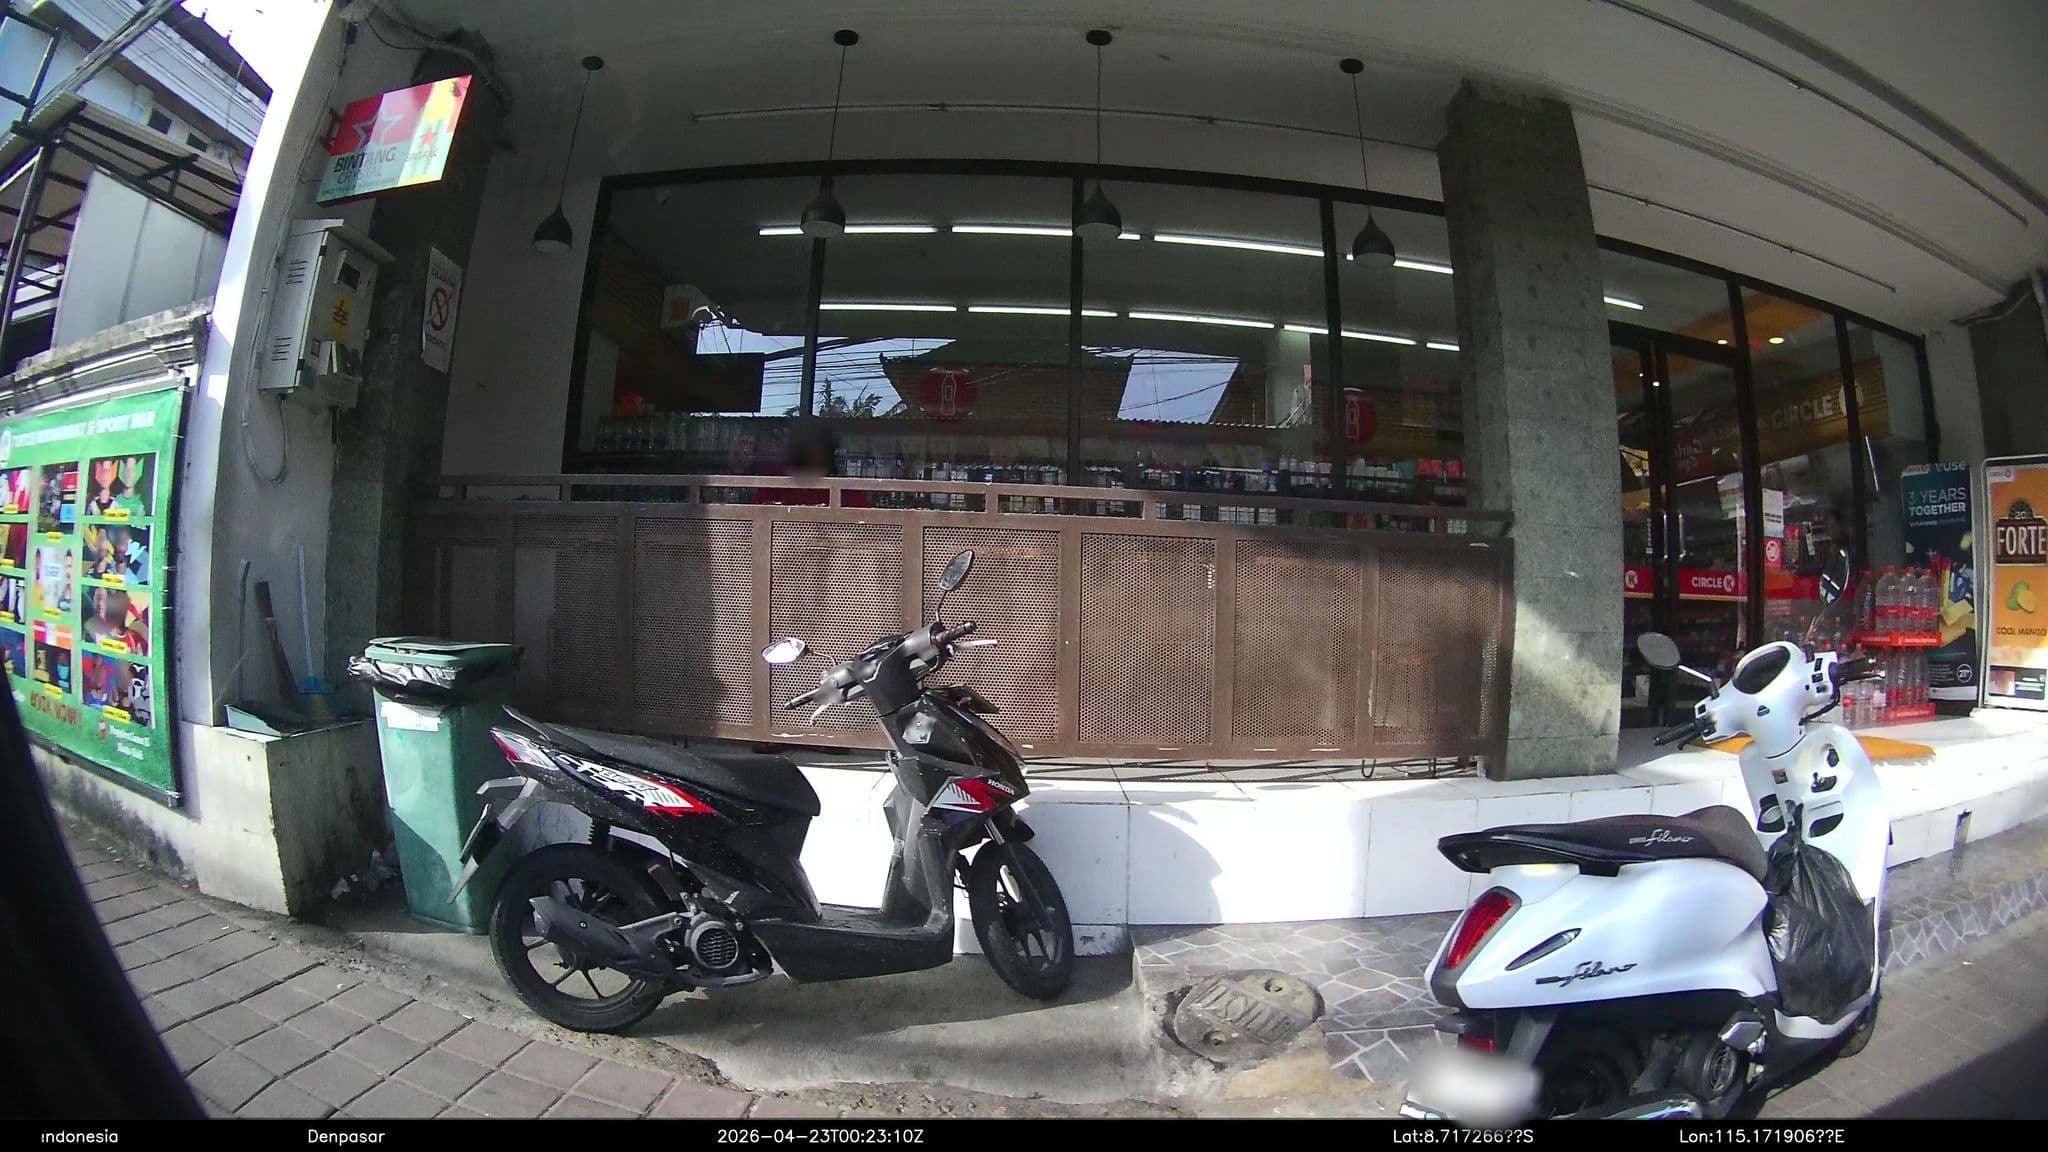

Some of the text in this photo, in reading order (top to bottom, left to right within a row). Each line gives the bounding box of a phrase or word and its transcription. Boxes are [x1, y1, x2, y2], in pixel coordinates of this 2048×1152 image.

[1919, 487, 1967, 504] YEARS
[1908, 502, 1967, 516] TOGETHER
[1996, 526, 2047, 556] FORTE
[1691, 576, 1722, 588] CIRCLE
[2017, 626, 2047, 637] MANGO
[987, 778, 1015, 796] HONDA
